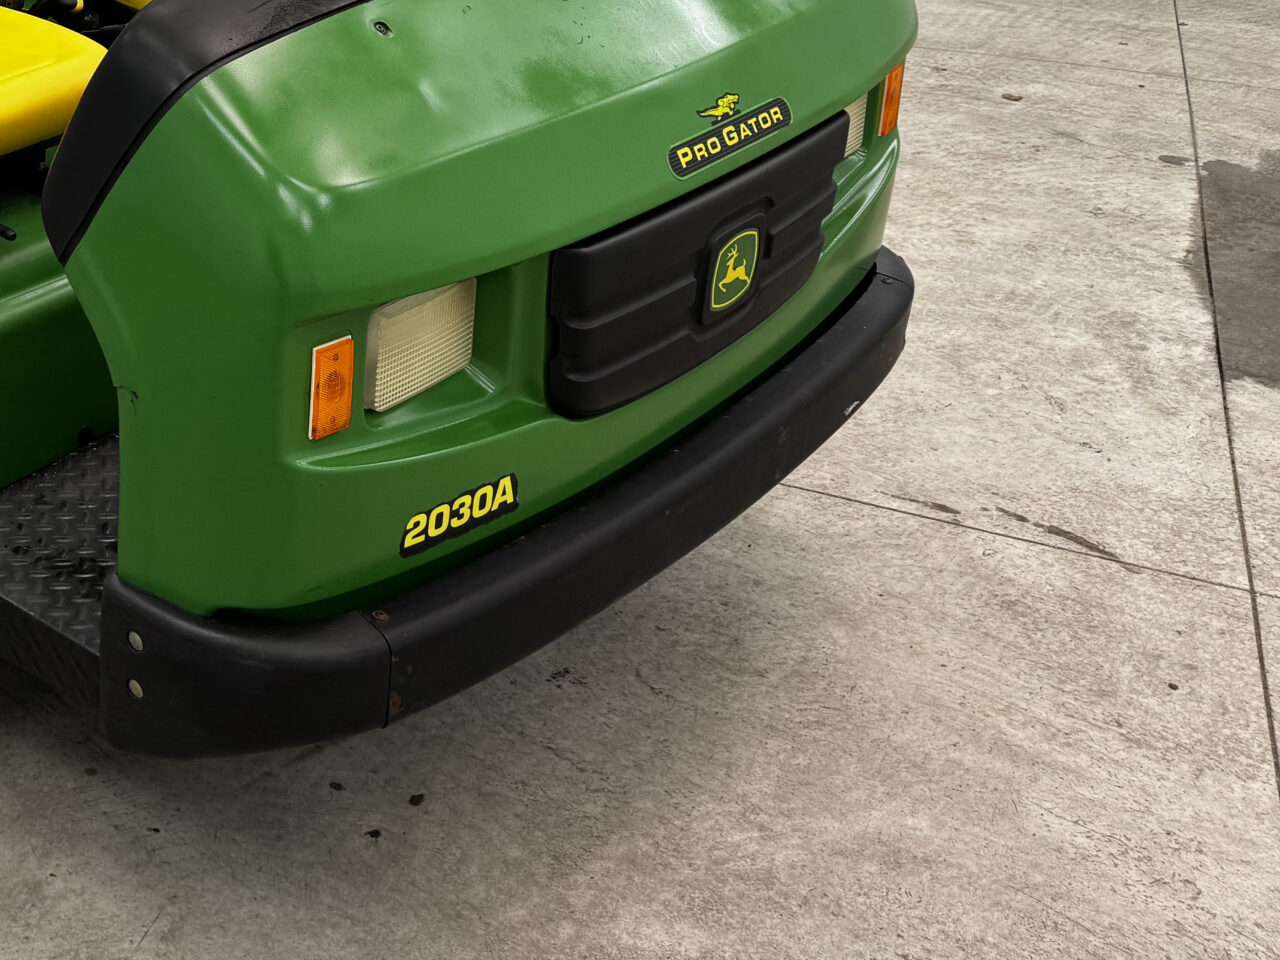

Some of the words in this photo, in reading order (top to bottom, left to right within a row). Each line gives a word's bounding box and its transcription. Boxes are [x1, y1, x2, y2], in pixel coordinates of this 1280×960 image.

[676, 136, 722, 169] PRO
[722, 106, 784, 146] GATOR
[404, 475, 515, 548] 2030A
